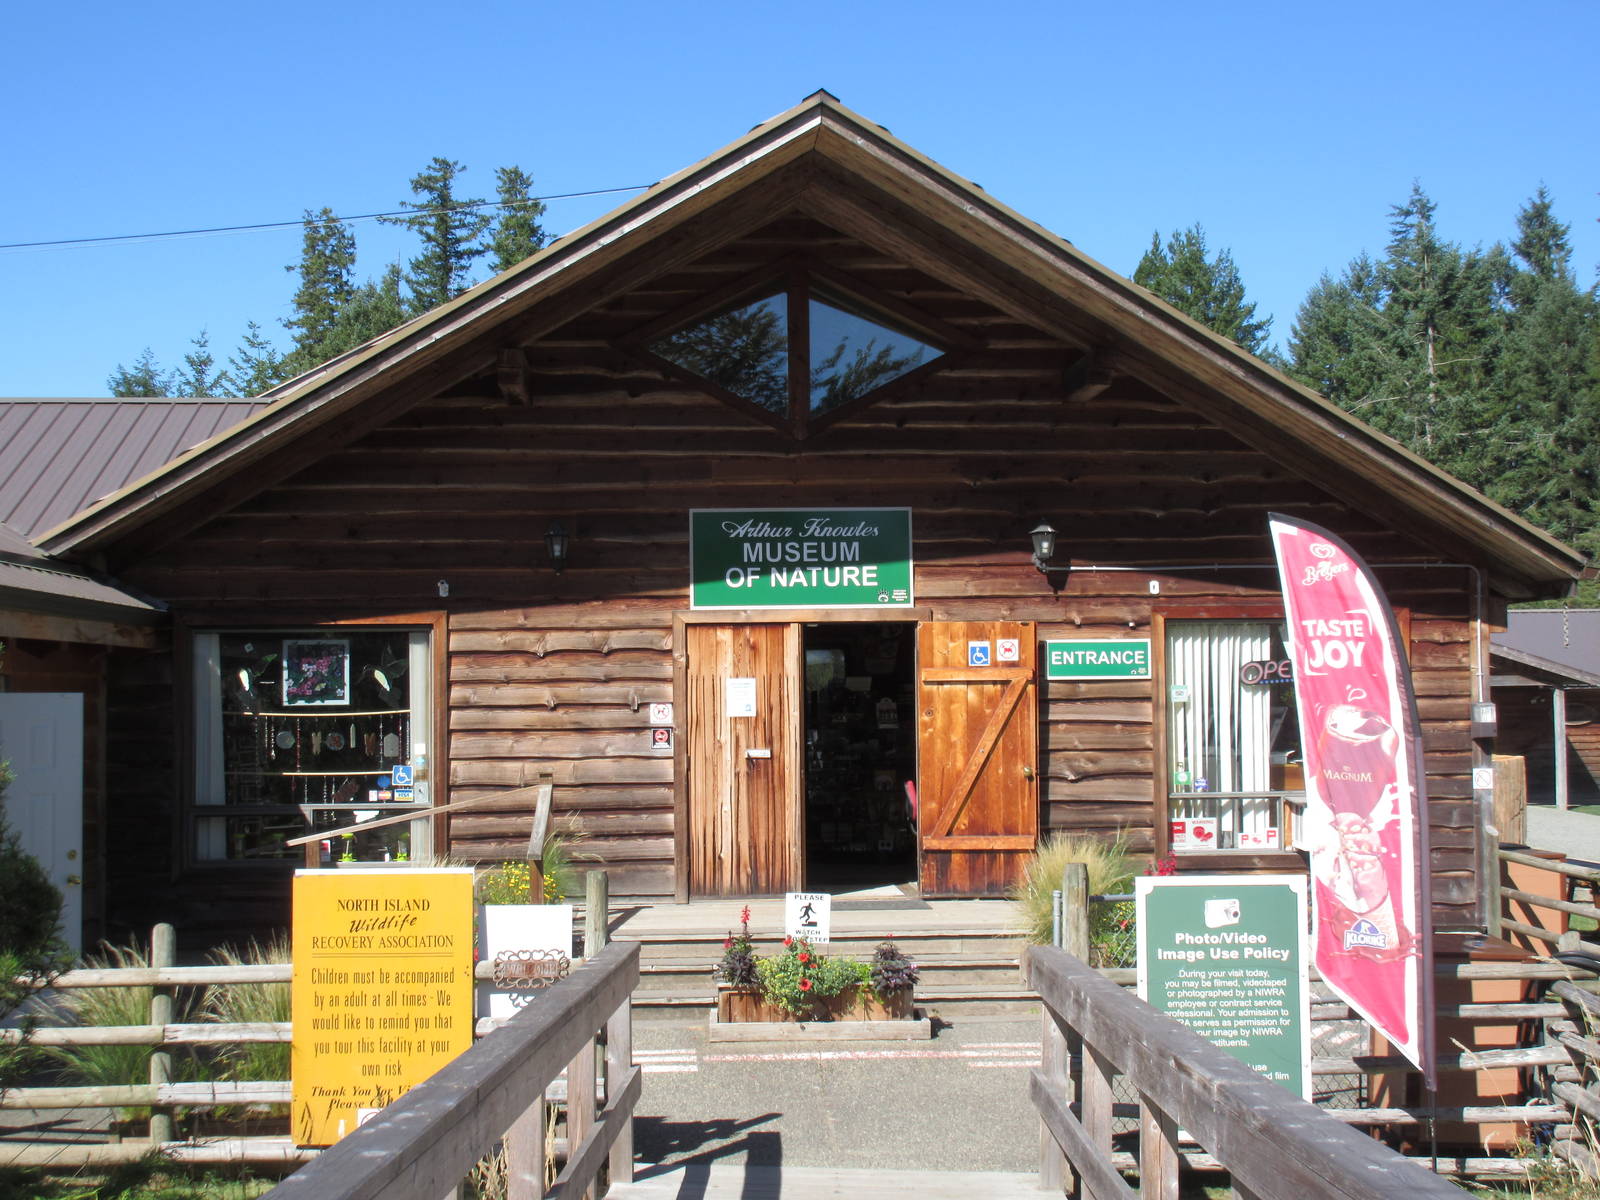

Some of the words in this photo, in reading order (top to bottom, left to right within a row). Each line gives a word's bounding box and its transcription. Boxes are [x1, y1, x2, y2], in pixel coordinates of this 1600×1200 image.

[721, 518, 793, 538] Arthur
[799, 517, 880, 538] Knowles
[743, 541, 860, 562] MUSEUM
[725, 566, 761, 588] OF
[770, 565, 878, 588] NATURE
[1302, 619, 1365, 637] TASTE
[1051, 650, 1145, 665] ENTRANCE
[1310, 640, 1366, 668] JOY
[1241, 660, 1292, 685] OPE
[1323, 769, 1373, 783] MAGNUM
[337, 899, 379, 912] NORTH
[384, 899, 430, 912] ISLAND
[349, 914, 417, 933] Wildlife
[312, 936, 374, 949] RECOVERY
[378, 934, 454, 949] ASSOCIATION
[1175, 932, 1267, 945] Photo/Video
[1157, 948, 1205, 962] Image
[1209, 947, 1239, 959] Use
[1244, 947, 1290, 961] Policy
[311, 967, 349, 985] Children
[353, 969, 375, 985] must
[379, 967, 390, 985] be
[394, 967, 455, 987] accompanied
[1179, 969, 1206, 979] During
[1207, 970, 1226, 979] your
[1227, 969, 1244, 978] visit
[1164, 980, 1180, 989] you
[1181, 980, 1200, 989] may
[1201, 979, 1212, 988] be
[1213, 979, 1241, 988] filmed,
[1243, 978, 1287, 988] videotaped
[314, 991, 324, 1010] by
[329, 995, 340, 1007] an
[344, 991, 367, 1007] adult
[372, 993, 381, 1007] at
[385, 991, 397, 1007] all
[401, 991, 427, 1007] times
[436, 990, 451, 1007] We
[1166, 990, 1176, 998] or
[1177, 989, 1233, 999] photographed
[1235, 989, 1245, 999] by
[1254, 988, 1285, 997] NIWRA
[1167, 1000, 1207, 1010] employee
[1219, 999, 1253, 1008] contract
[1253, 999, 1283, 1007] service
[1217, 1008, 1237, 1017] Your
[1238, 1008, 1279, 1017] admission
[1280, 1008, 1289, 1016] to
[312, 1014, 339, 1030] would
[344, 1014, 361, 1030] like
[365, 1016, 375, 1030] to
[379, 1014, 410, 1030] remind
[414, 1017, 430, 1032] you
[434, 1015, 452, 1029] that
[1233, 1018, 1278, 1028] permission
[1279, 1018, 1291, 1026] for
[1213, 1028, 1239, 1038] image
[1240, 1028, 1250, 1037] by
[1252, 1027, 1283, 1036] NIWRA
[314, 1041, 330, 1058] you
[334, 1039, 353, 1054] tour
[357, 1038, 375, 1054] this
[379, 1037, 413, 1056] facility
[416, 1039, 426, 1053] at
[430, 1040, 450, 1056] your
[361, 1064, 381, 1077] own
[384, 1060, 402, 1076] risk
[1252, 1064, 1267, 1072] use
[1275, 1071, 1290, 1080] film
[312, 1086, 346, 1097] Thank
[352, 1085, 371, 1096] You
[329, 1098, 365, 1109] Please
